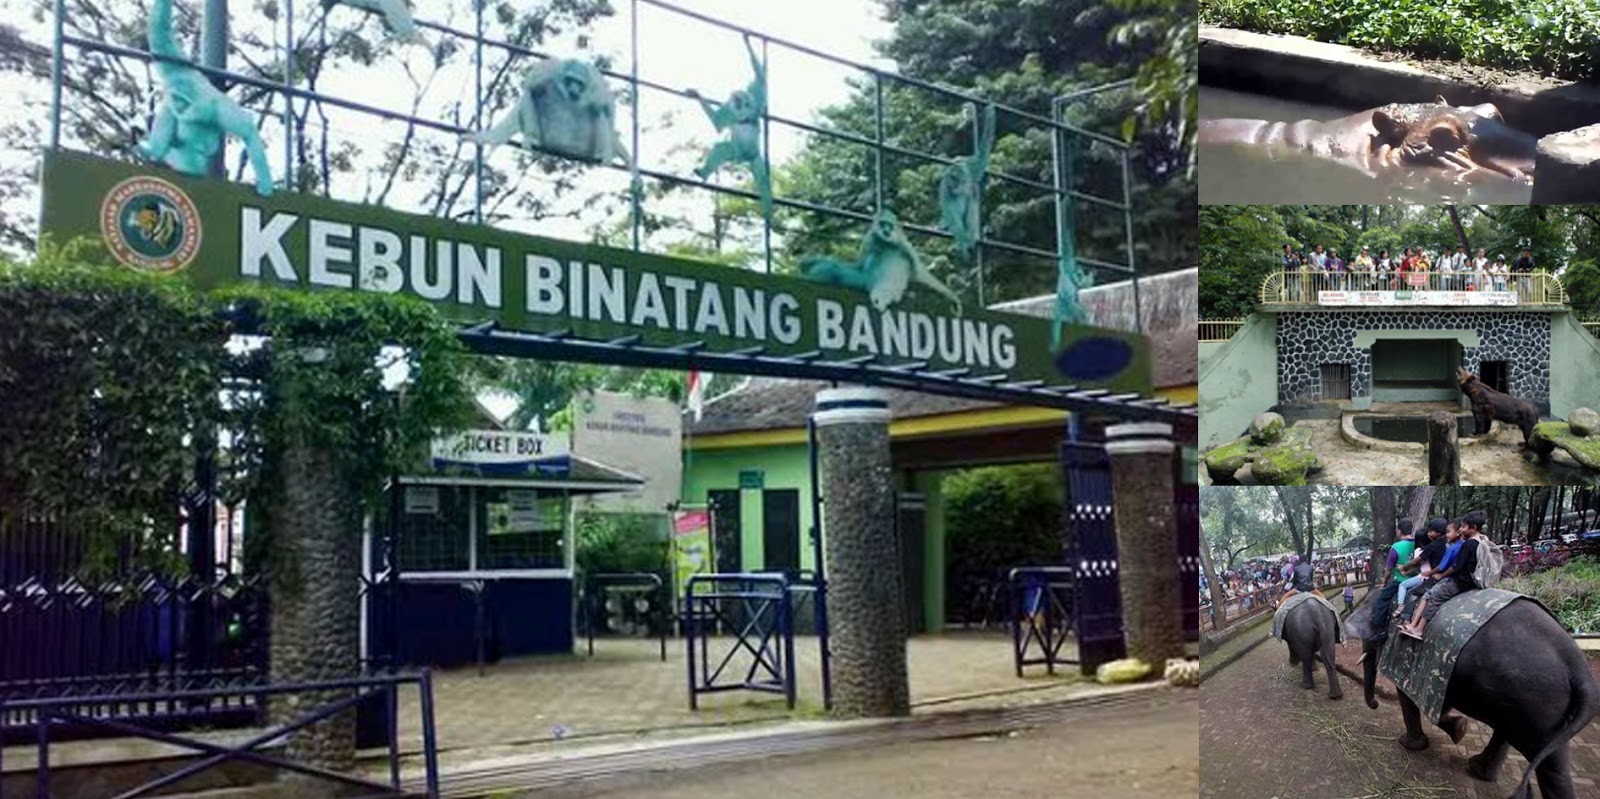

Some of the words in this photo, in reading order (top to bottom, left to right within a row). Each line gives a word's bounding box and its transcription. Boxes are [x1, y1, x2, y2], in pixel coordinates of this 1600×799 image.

[240, 206, 502, 309] KEBUN
[525, 255, 801, 344] BINATANG
[816, 299, 1016, 369] BANDUNG
[463, 434, 510, 453] TICKET
[516, 437, 544, 455] BOX
